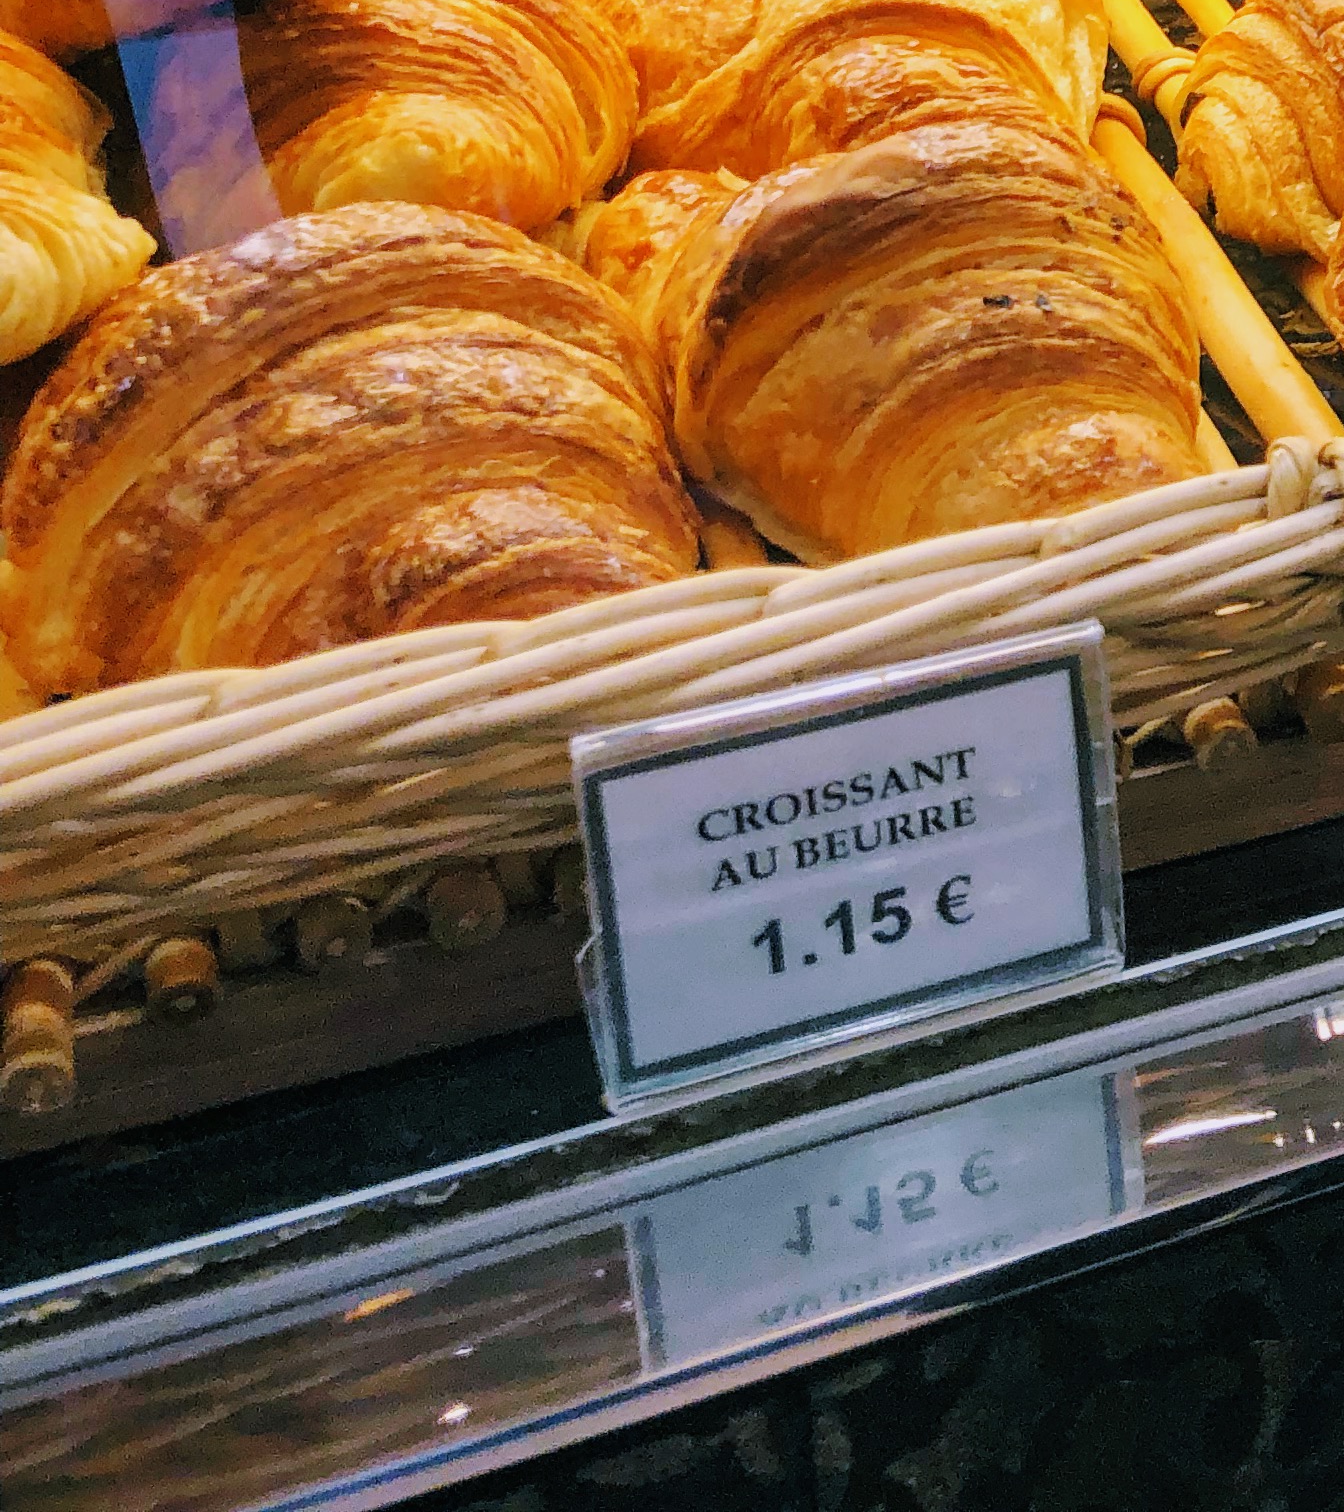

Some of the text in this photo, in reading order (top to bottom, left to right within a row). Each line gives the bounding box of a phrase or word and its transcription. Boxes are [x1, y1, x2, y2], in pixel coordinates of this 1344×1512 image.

[697, 747, 977, 842] CROISSANT
[711, 796, 977, 891] AU BEURRE
[751, 873, 976, 974] 1.15 €
